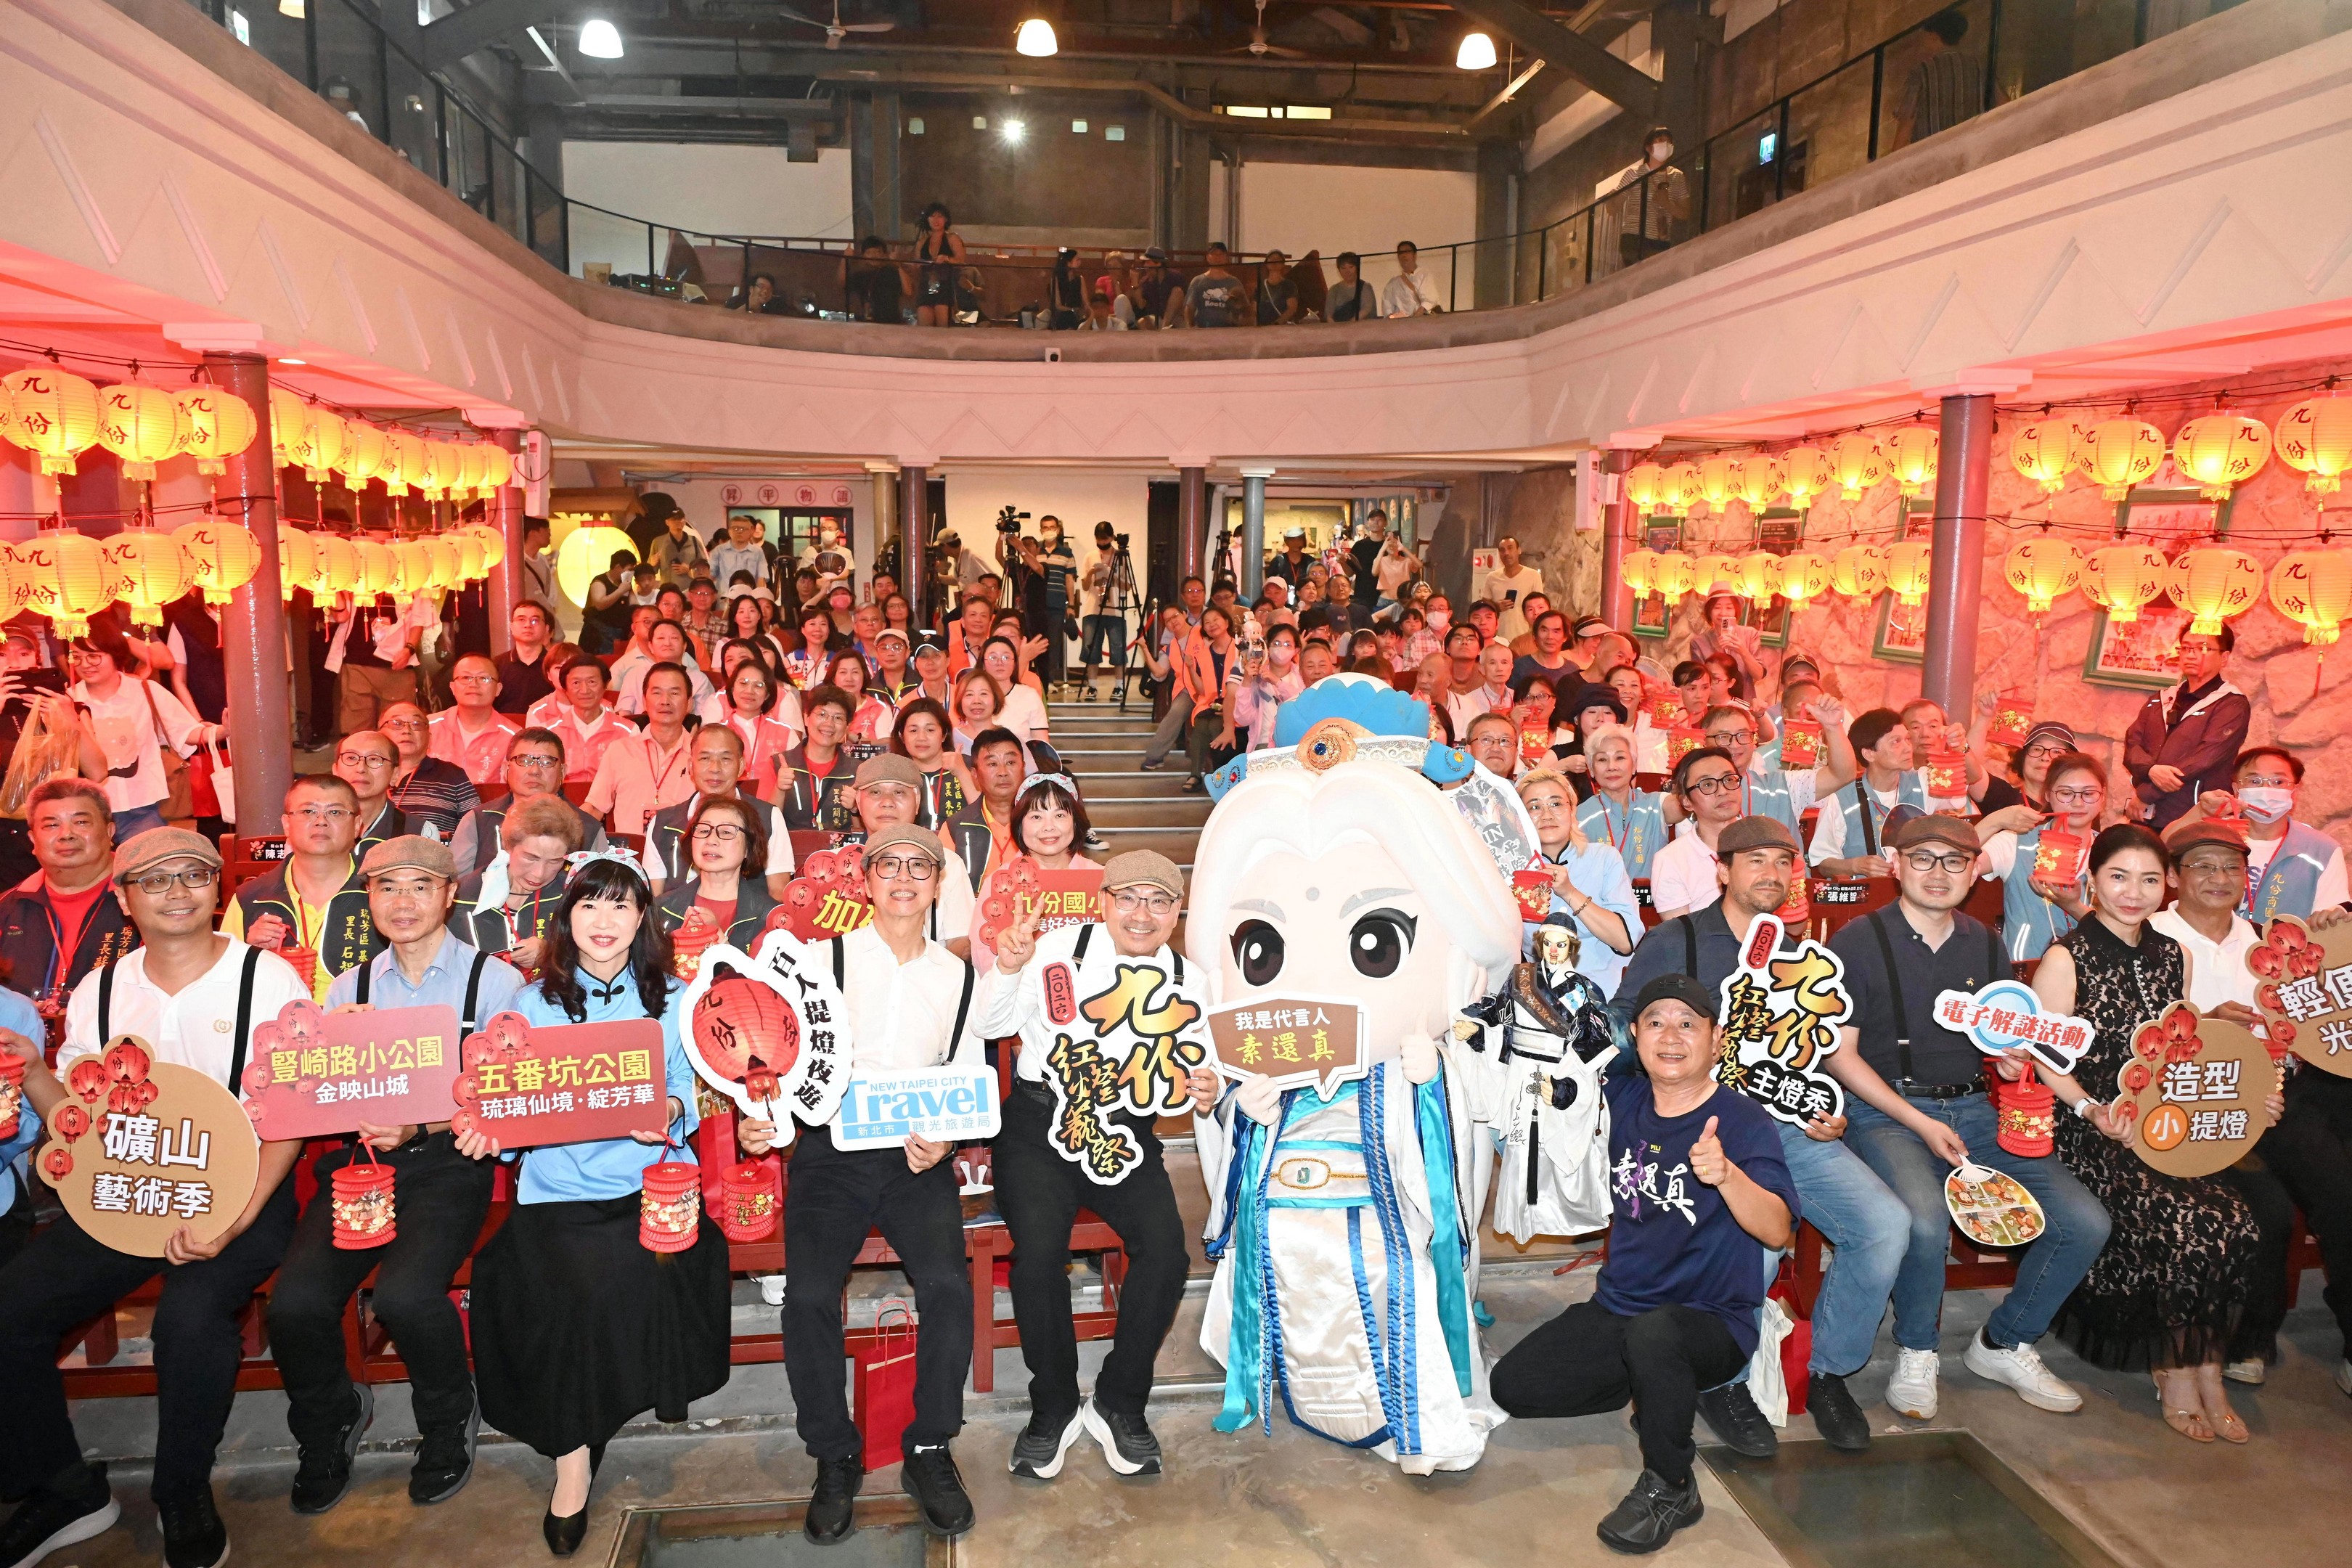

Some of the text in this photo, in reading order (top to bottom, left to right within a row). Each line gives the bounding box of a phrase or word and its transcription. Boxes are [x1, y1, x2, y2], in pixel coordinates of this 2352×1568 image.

[20, 377, 53, 436] 九份
[108, 393, 132, 444] 九份
[191, 397, 213, 444] 九份
[2019, 428, 2038, 468] 九份
[2081, 430, 2096, 473] 九份
[2133, 428, 2157, 473] 九份
[2229, 427, 2259, 474] 九份
[2287, 407, 2311, 460] 九份
[1864, 445, 1882, 480] 九份
[726, 489, 849, 503] 昇平物語
[116, 543, 138, 594] 九份
[192, 530, 215, 575] 九份
[1861, 548, 1878, 581] 九份
[2013, 545, 2032, 585] 九份
[2065, 547, 2083, 586] 九份
[2139, 553, 2160, 597] 九份
[29, 550, 58, 605] 九份
[2085, 558, 2099, 600] 九份
[2169, 556, 2190, 602] 九份
[2229, 558, 2255, 605] 九份
[2284, 563, 2307, 614] 九份
[1827, 891, 1858, 902] 張維智
[701, 990, 737, 1052] 九份
[768, 947, 836, 1111] 百人提燈夜遊
[1235, 1007, 1331, 1031] 我是代言人
[1764, 949, 1846, 1070] 九份
[1943, 998, 2087, 1050] 電子解謎活動
[271, 1035, 444, 1084] 豎崎路小公園
[1081, 965, 1204, 1108] 九份
[1236, 1028, 1336, 1065] 素還真
[2319, 1018, 2352, 1055] 光
[315, 1074, 409, 1104] 金映山城
[477, 1049, 651, 1095] 五番坑公園
[870, 1076, 967, 1092] NEW TAIPEI CITY
[1747, 1066, 1832, 1119] 主燈秀
[2160, 1060, 2240, 1103] 造型
[841, 1077, 989, 1124] Travel
[103, 1112, 211, 1170] 礦山
[858, 1116, 990, 1137] 新北市 觀光旅遊局
[93, 1173, 212, 1219] 藝術季
